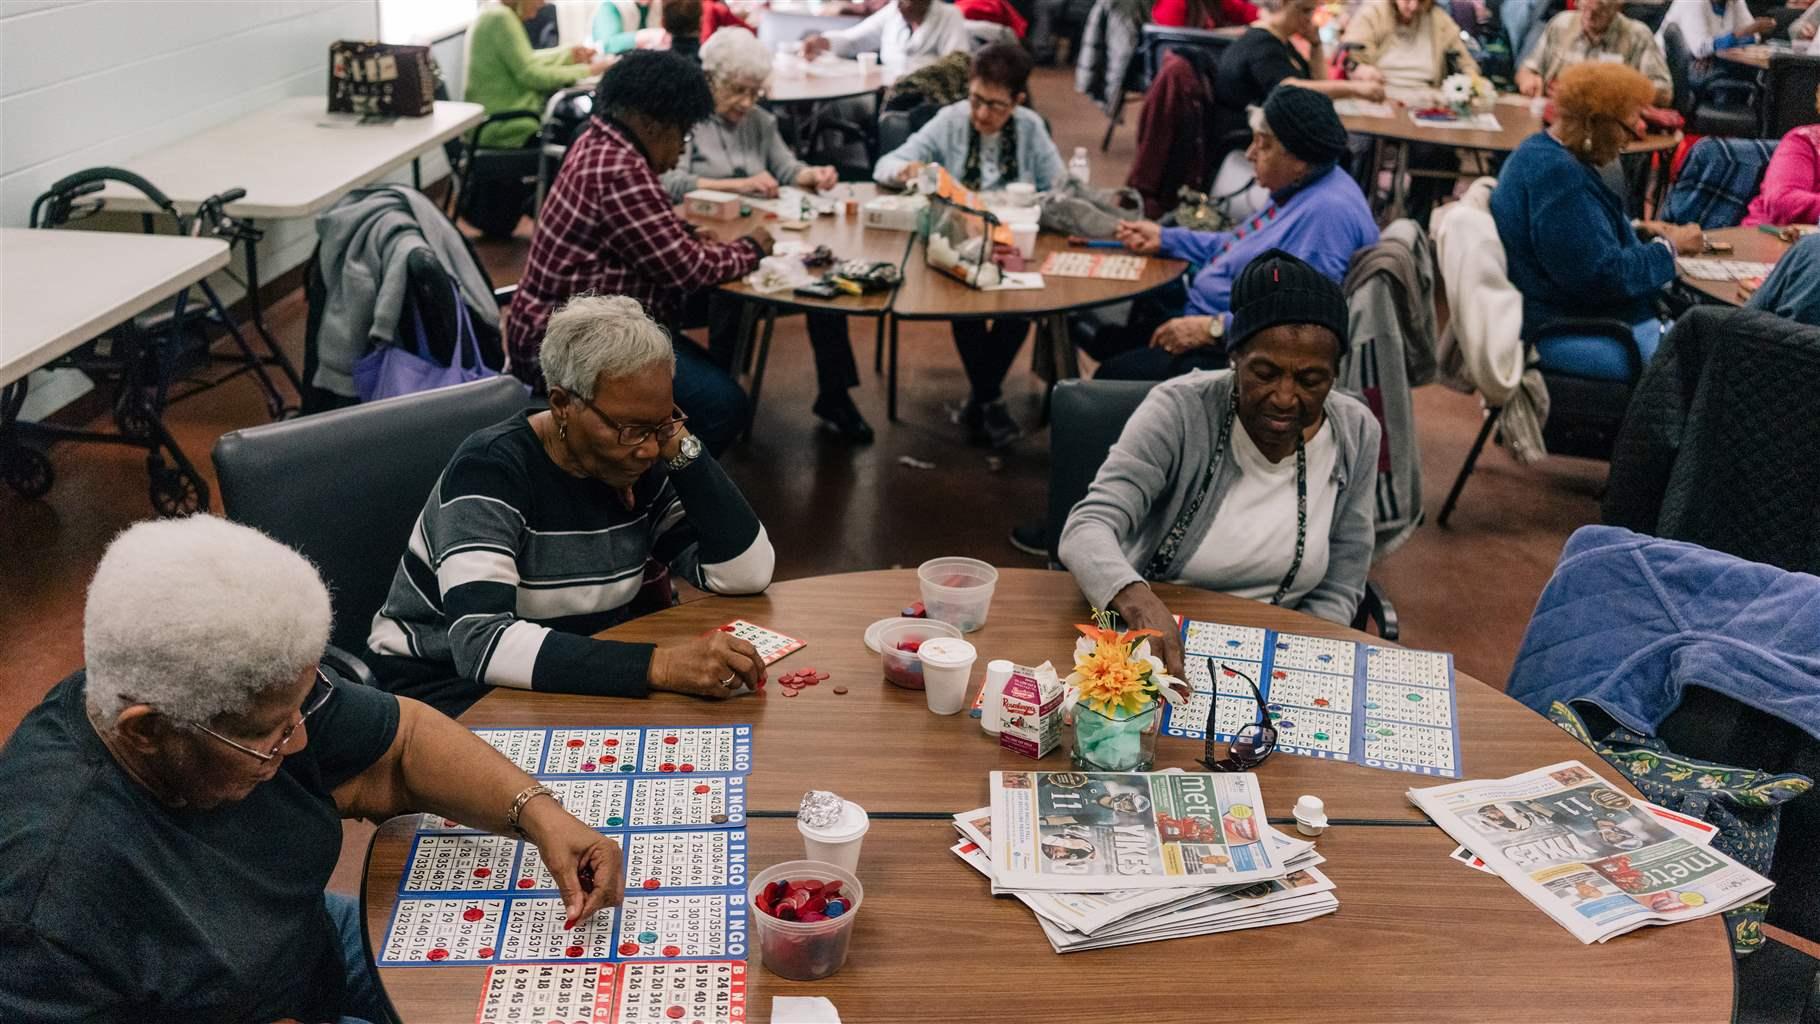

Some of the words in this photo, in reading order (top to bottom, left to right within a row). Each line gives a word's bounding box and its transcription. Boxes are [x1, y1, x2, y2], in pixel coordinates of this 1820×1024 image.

[713, 833, 723, 841] 10
[419, 847, 434, 857] 17
[439, 847, 454, 857] 18
[633, 845, 644, 854] 23
[692, 844, 703, 852] 25
[713, 844, 723, 852] 30
[1113, 824, 1152, 876] YIKES
[416, 858, 431, 868] 33
[632, 856, 642, 865] 40
[692, 854, 702, 863] 45
[712, 854, 723, 862] 36
[729, 832, 744, 885] BINGO
[436, 859, 448, 868] 35
[412, 870, 425, 879] 59
[433, 870, 445, 879] 48
[631, 867, 642, 876] 46
[692, 865, 702, 874] 49
[712, 865, 722, 874] 47
[1644, 852, 1718, 888] metr
[409, 880, 424, 890] 72
[430, 880, 444, 890] 75
[630, 878, 644, 887] 75
[691, 876, 702, 884] 61
[712, 876, 722, 885] 64
[648, 898, 658, 907] 10
[710, 896, 721, 905] 13
[402, 902, 415, 910] 13
[466, 901, 479, 911] 12
[398, 913, 412, 923] 22
[420, 913, 433, 923] 24
[513, 912, 525, 921] 24
[534, 912, 546, 921] 22
[646, 908, 658, 919] 17
[688, 908, 700, 918] 30
[710, 908, 721, 918] 27
[460, 925, 473, 934] 39
[510, 924, 522, 933] 37
[531, 923, 544, 933] 32
[646, 921, 657, 931] 32
[688, 920, 699, 930] 39
[710, 920, 721, 929] 35
[729, 895, 745, 955] BINGO
[394, 926, 408, 935] 32
[416, 925, 429, 935] 40
[413, 938, 426, 946] 51
[457, 937, 469, 947] 46
[507, 936, 519, 946] 48
[529, 936, 541, 946] 53
[688, 933, 698, 942] 57
[709, 932, 720, 942] 50
[391, 938, 404, 948] 54
[454, 949, 467, 959] 74
[504, 948, 517, 958] 73
[527, 948, 539, 957] 71
[643, 946, 655, 956] 72
[686, 945, 698, 955] 65
[709, 944, 720, 954] 74
[387, 950, 400, 960] 73
[409, 950, 422, 960] 65
[631, 966, 643, 975] 14
[653, 966, 664, 975] 12
[696, 965, 707, 974] 15
[492, 979, 504, 990] 22
[514, 979, 527, 989] 29
[560, 978, 570, 989] 28
[583, 978, 592, 988] 27
[630, 978, 642, 989] 26
[652, 978, 664, 989] 20
[696, 978, 707, 988] 19
[718, 977, 728, 988] 24
[488, 993, 501, 1004] 34
[511, 992, 524, 1003] 45
[558, 992, 569, 1003] 38
[581, 992, 590, 1002] 41
[596, 966, 612, 1024] BING
[628, 994, 640, 1003] 31
[650, 992, 662, 1004] 34
[694, 991, 706, 1002] 40
[717, 992, 728, 1001] 41
[732, 966, 744, 1024] BING
[486, 1008, 498, 1019] 53
[508, 1007, 521, 1018] 50
[556, 1006, 567, 1017] 57
[579, 1006, 589, 1017] 47
[626, 1007, 638, 1018] 58
[649, 1007, 661, 1018] 59
[694, 1006, 706, 1016] 55
[716, 1005, 728, 1016] 52
